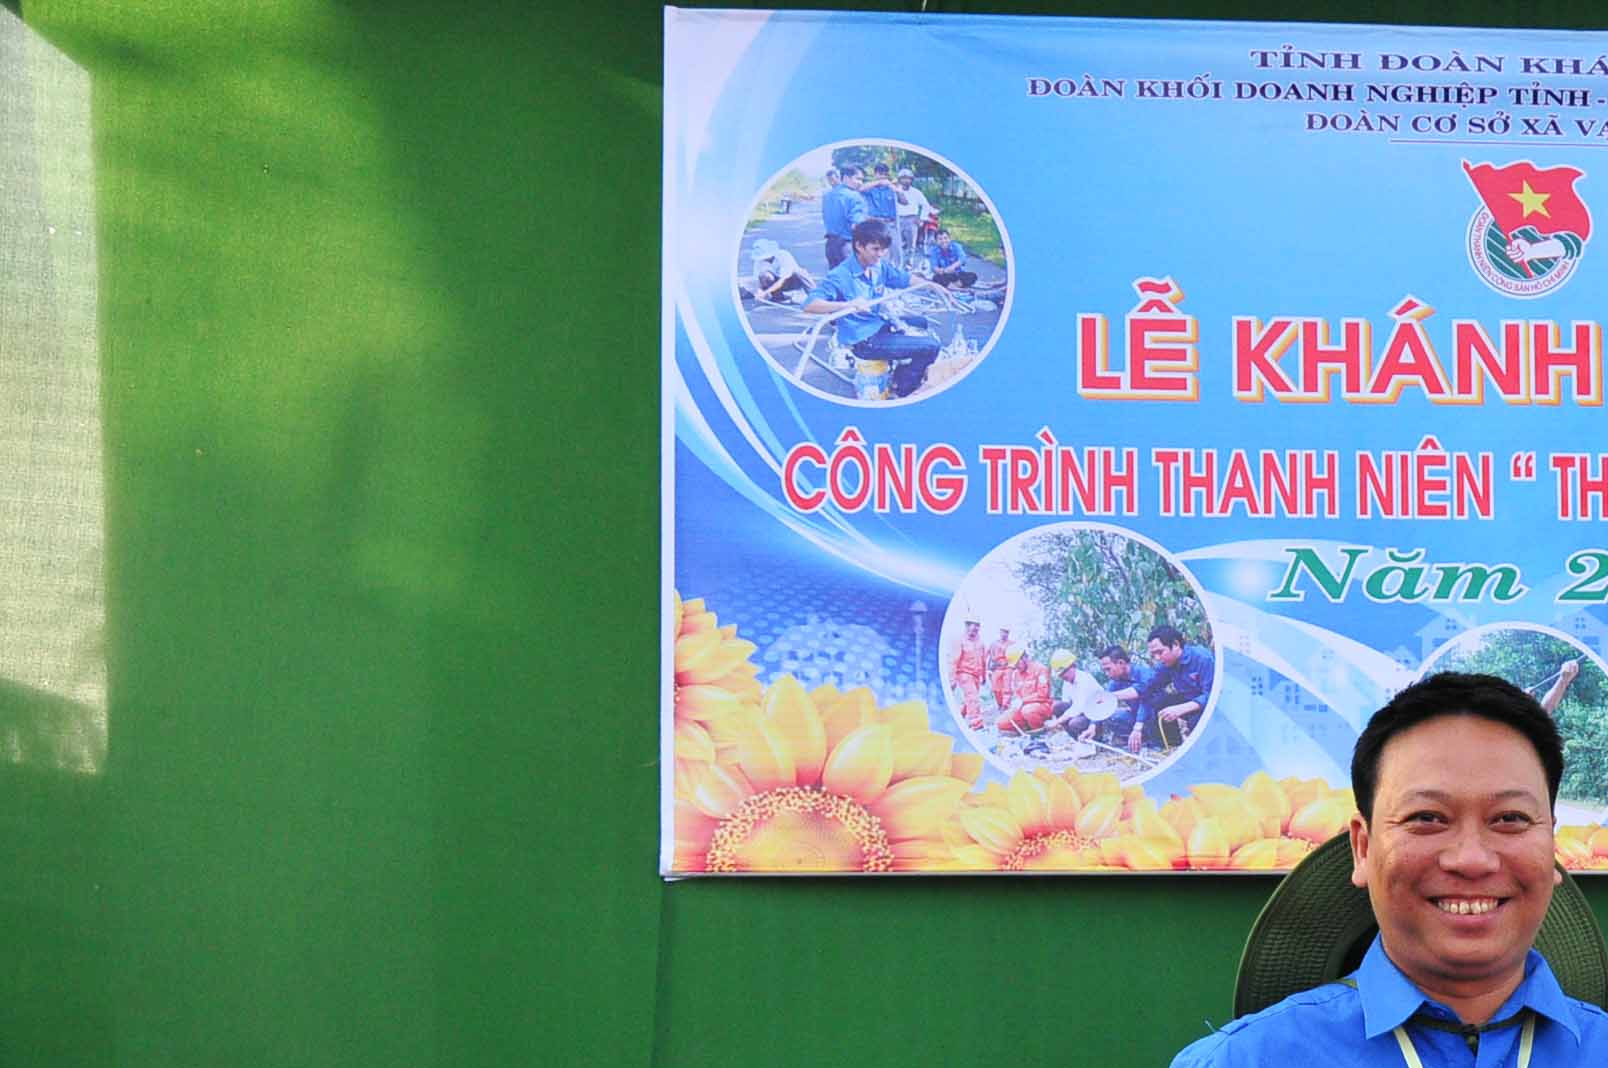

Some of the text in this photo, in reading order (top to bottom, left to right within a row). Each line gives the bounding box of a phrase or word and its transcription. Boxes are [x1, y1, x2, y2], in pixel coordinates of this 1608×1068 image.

[1250, 45, 1360, 71] TỈNH
[1380, 50, 1504, 73] ĐOÀN
[1028, 75, 1125, 98] ĐOÀN
[1136, 73, 1222, 99] KHỐI
[1234, 82, 1355, 102] DOANH
[1366, 83, 1497, 110] NGHIỆP
[1508, 81, 1590, 107] TỈNH
[1306, 108, 1400, 133] ĐOÀN
[1411, 112, 1457, 134] CƠ
[1468, 111, 1511, 135] SỞ
[1521, 115, 1562, 136] XÃ
[1076, 275, 1199, 400] LỄ
[1233, 294, 1603, 405] KHÁNH
[782, 427, 968, 513] CÔNG
[980, 426, 1138, 516] TRÌNH
[1153, 447, 1337, 519] THANH
[1356, 434, 1496, 521] NIÊN
[1269, 546, 1525, 606] Năm
